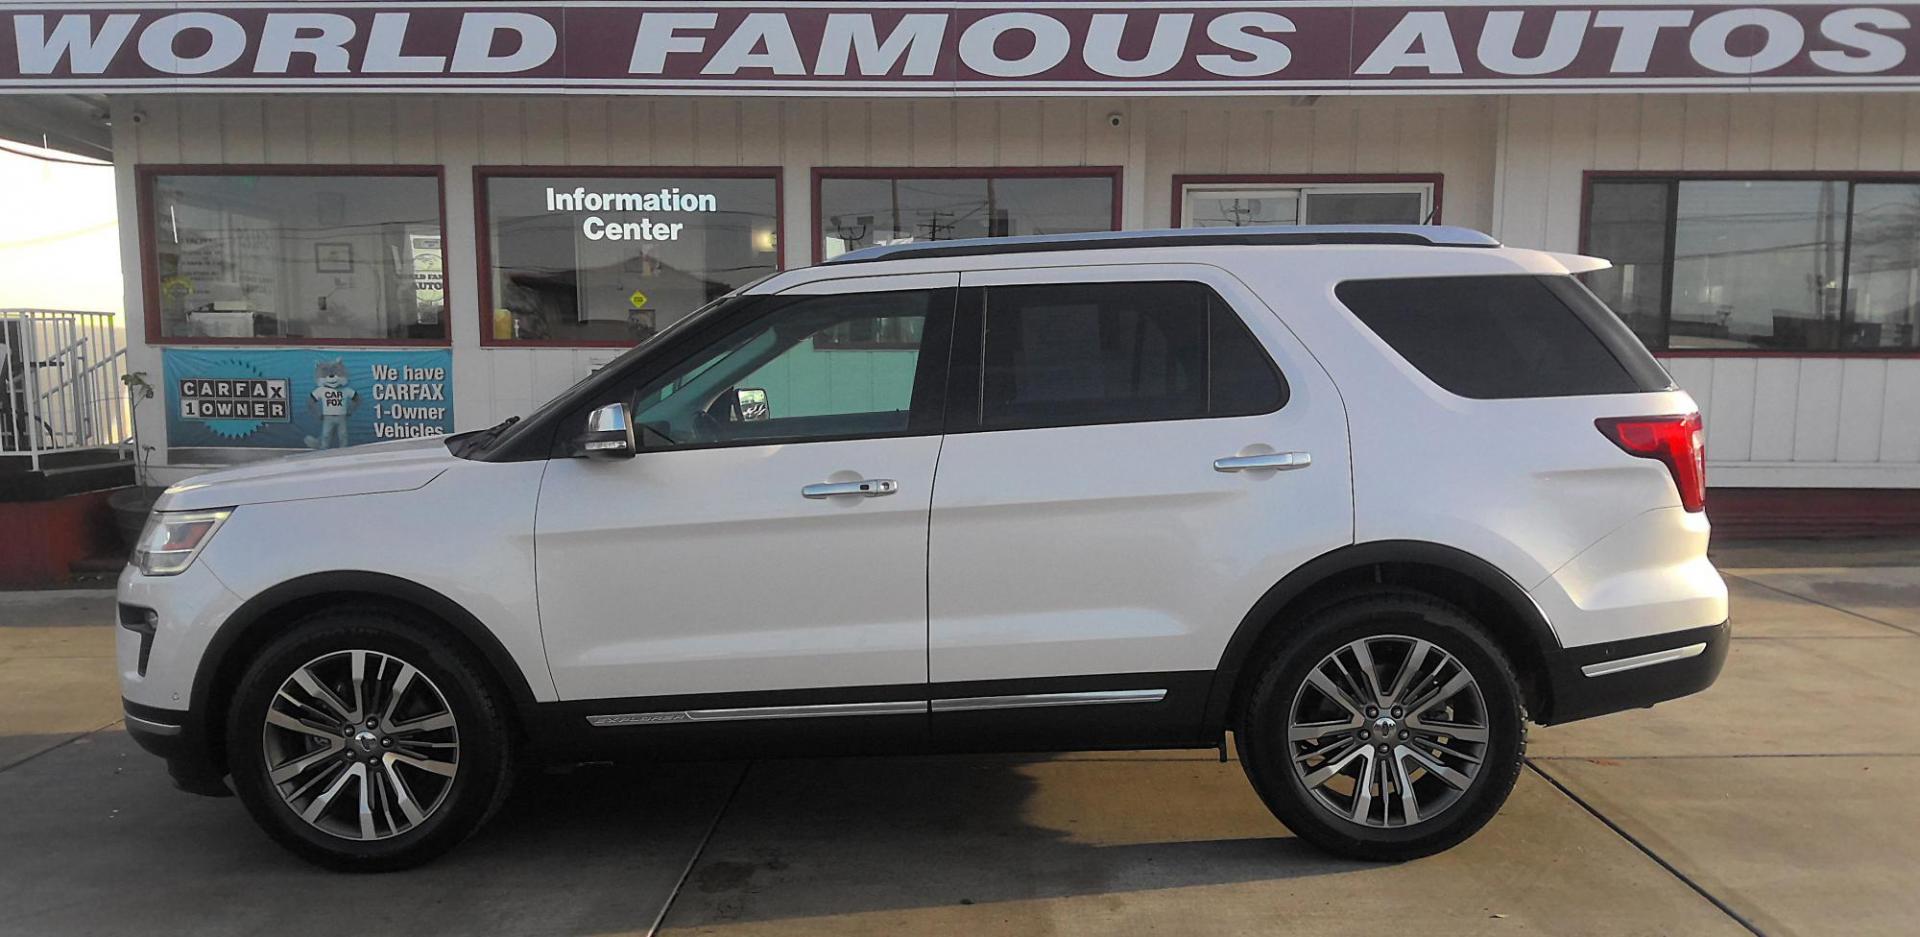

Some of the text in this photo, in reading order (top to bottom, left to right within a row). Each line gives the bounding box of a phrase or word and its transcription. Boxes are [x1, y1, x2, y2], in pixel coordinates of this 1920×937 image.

[14, 8, 1910, 77] WORLD FAMOUS AUTOS
[546, 187, 717, 212] Information
[582, 216, 684, 241] Center
[372, 364, 445, 381] We have
[182, 381, 283, 398] CARFAX
[324, 390, 343, 399] CAR
[372, 383, 445, 401] CARFAX
[326, 399, 343, 407] FOX
[373, 403, 446, 420] 1-Owner
[373, 422, 445, 438] Vehicles
